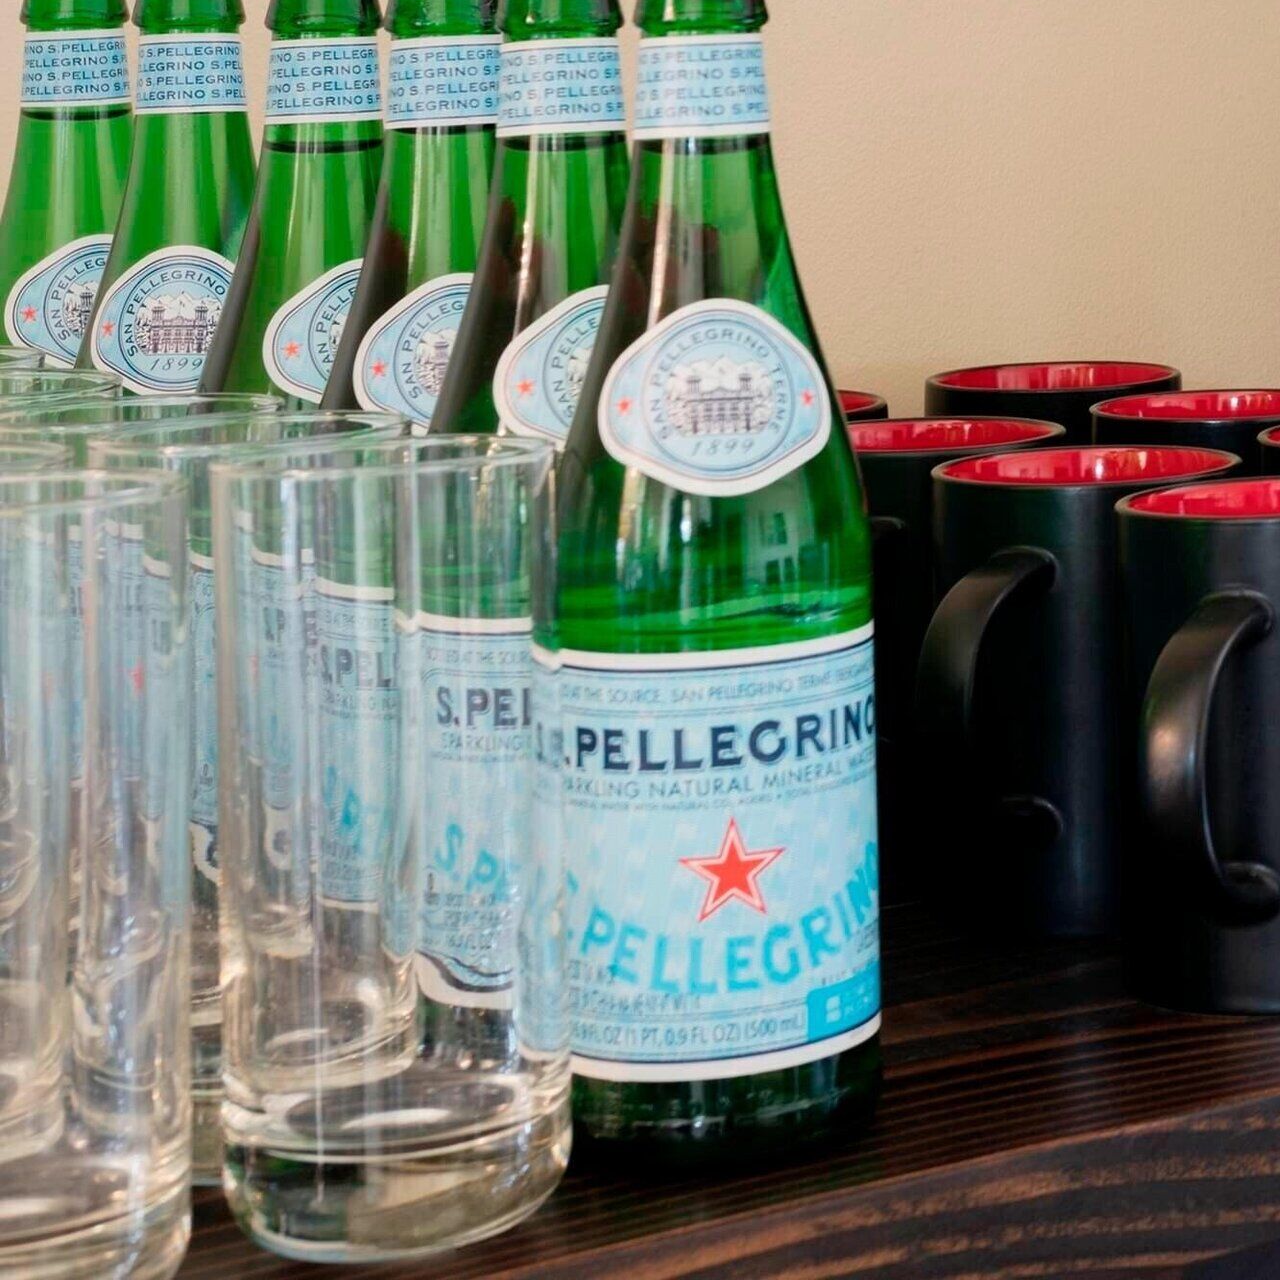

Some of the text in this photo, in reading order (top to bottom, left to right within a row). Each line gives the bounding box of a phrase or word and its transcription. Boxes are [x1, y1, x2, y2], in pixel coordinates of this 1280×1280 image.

[147, 46, 240, 58] S.PELLEGRINO
[146, 75, 243, 88] S.PELLEGRINO
[51, 309, 70, 341] SAN
[124, 270, 226, 357] SAN PELLEGRINO
[149, 357, 203, 372] 1899
[318, 342, 333, 370] AN
[401, 362, 422, 399] SAN
[651, 328, 786, 440] SAN PELLEGRINO TERME
[691, 439, 753, 457] 1899
[653, 774, 754, 799] NATURAL
[763, 759, 843, 789] MINERAL
